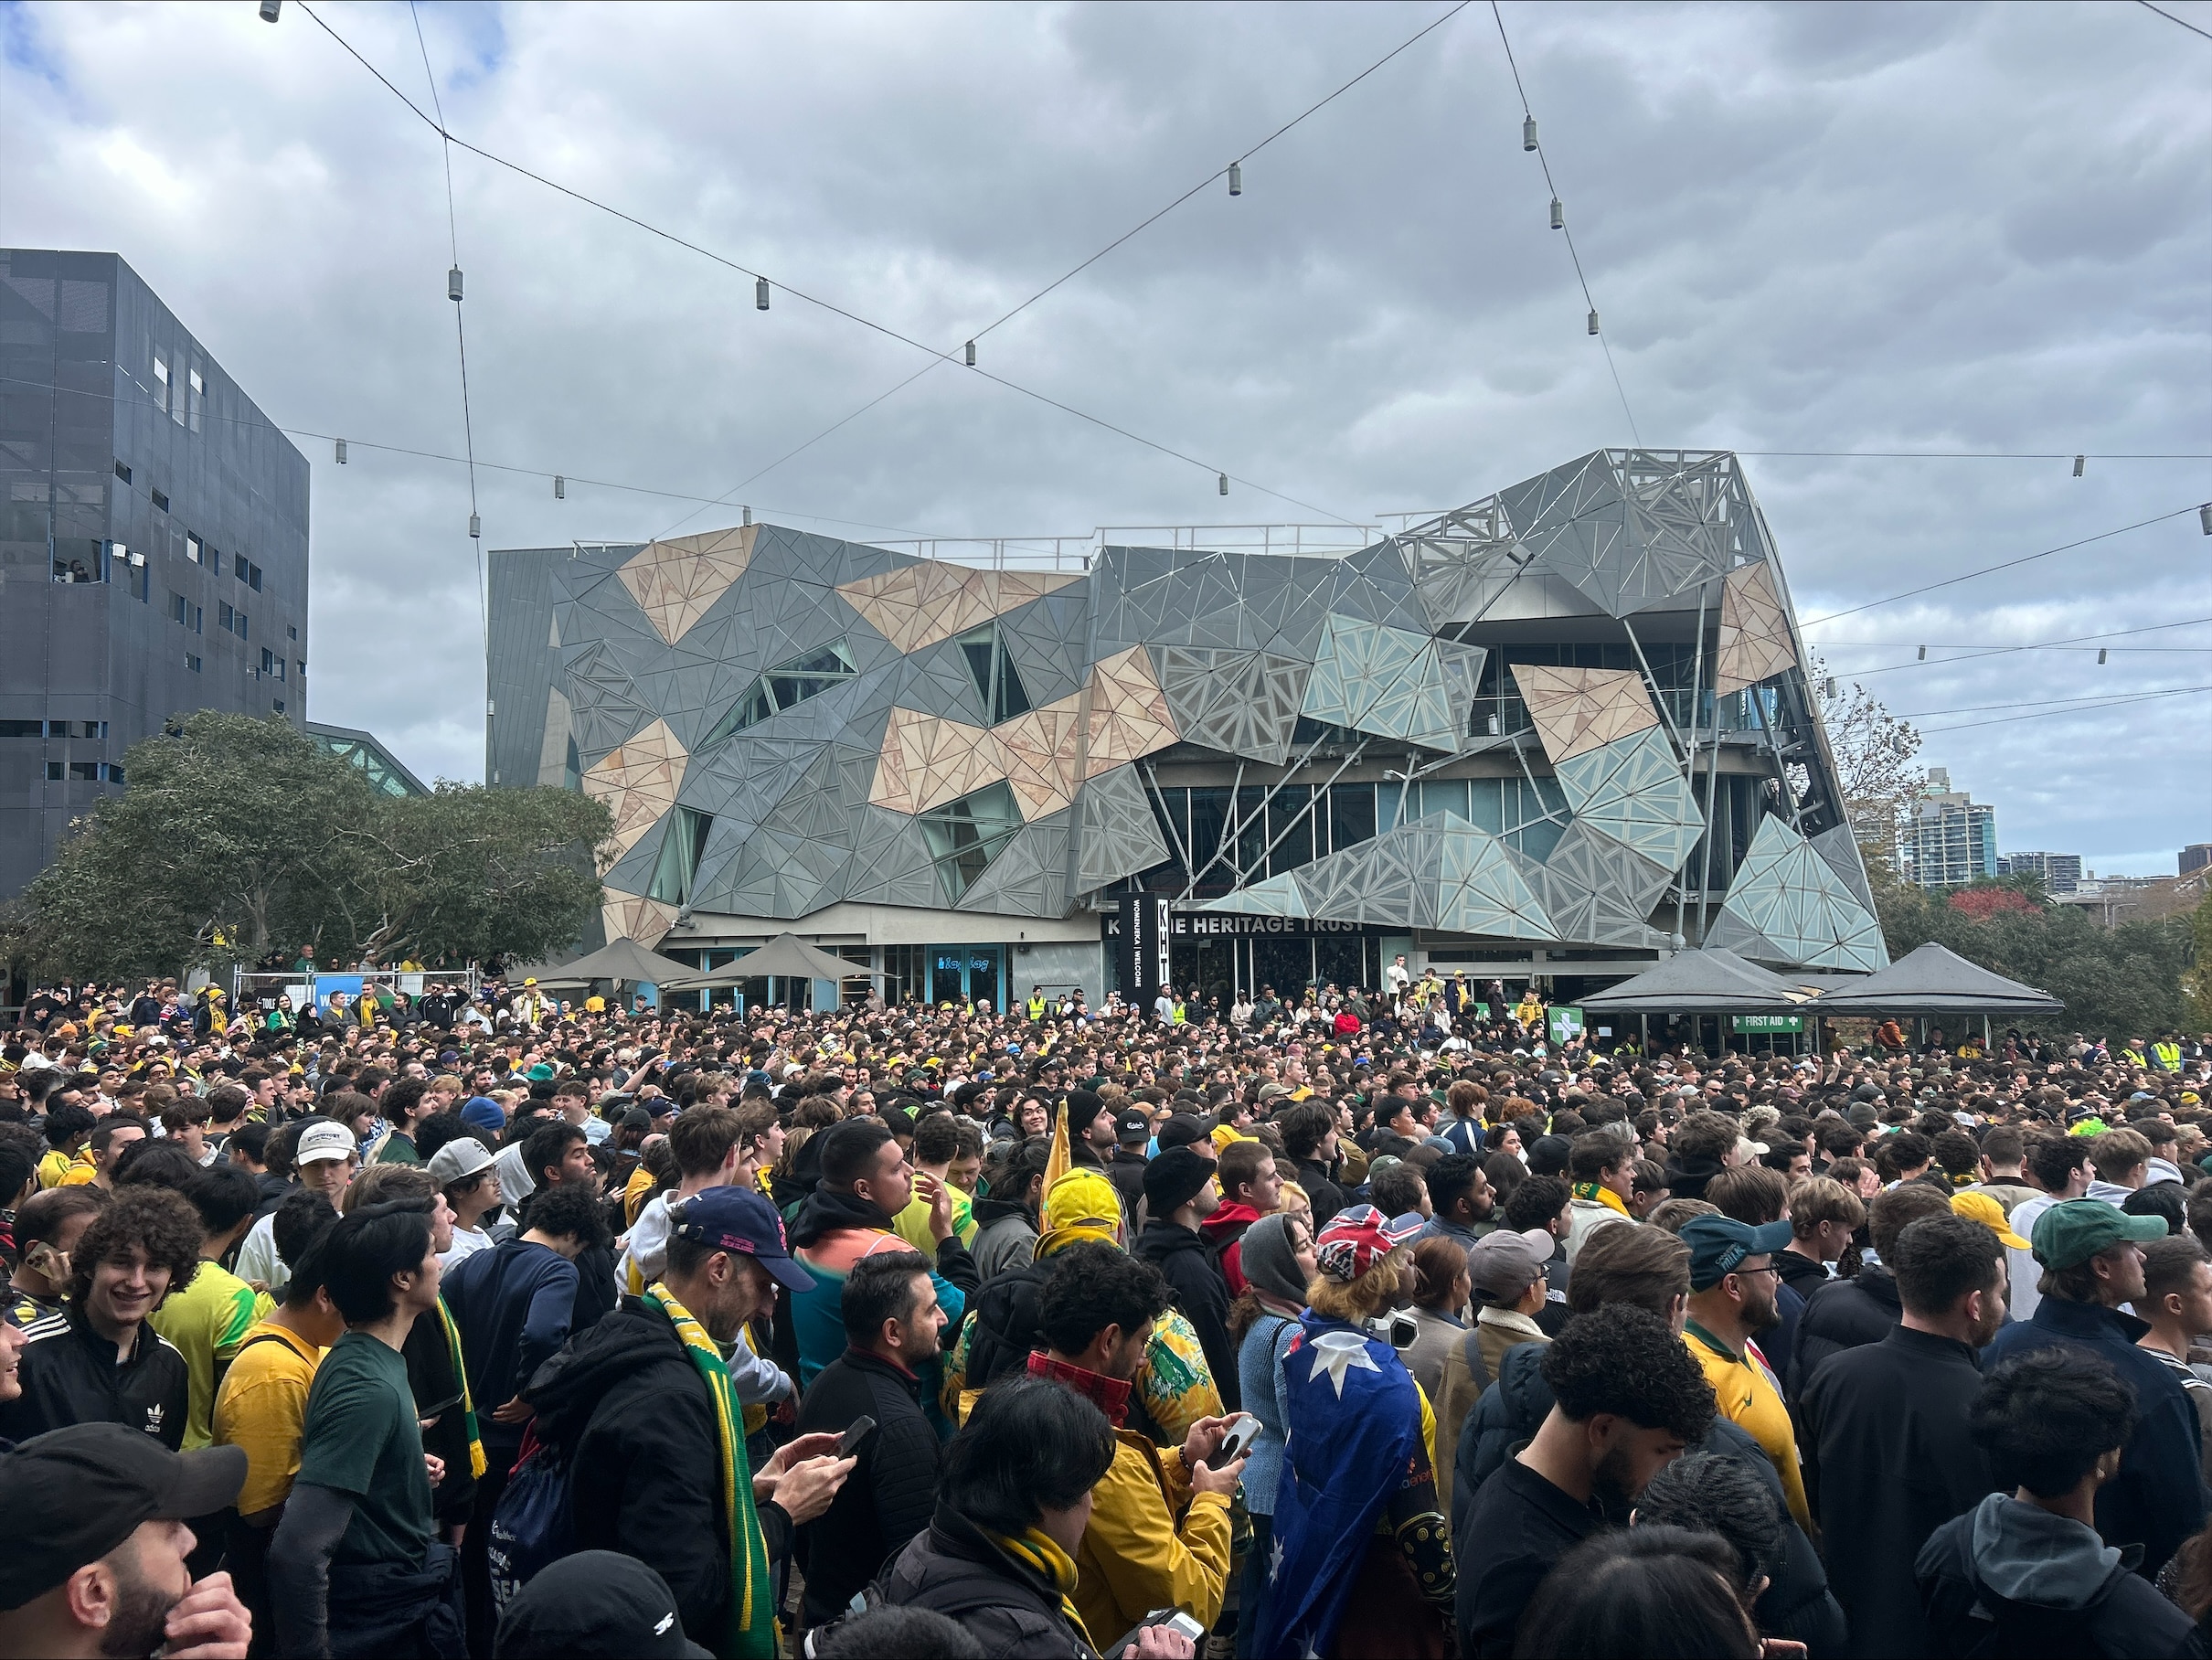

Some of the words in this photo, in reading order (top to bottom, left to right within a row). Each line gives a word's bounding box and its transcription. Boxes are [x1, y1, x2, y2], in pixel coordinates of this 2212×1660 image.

[1193, 917, 1294, 933] HERITAGE
[1159, 904, 1167, 981] KHT
[261, 997, 275, 1010] TOILE
[1745, 1016, 1768, 1027] FIRST
[1770, 1016, 1783, 1027] AID
